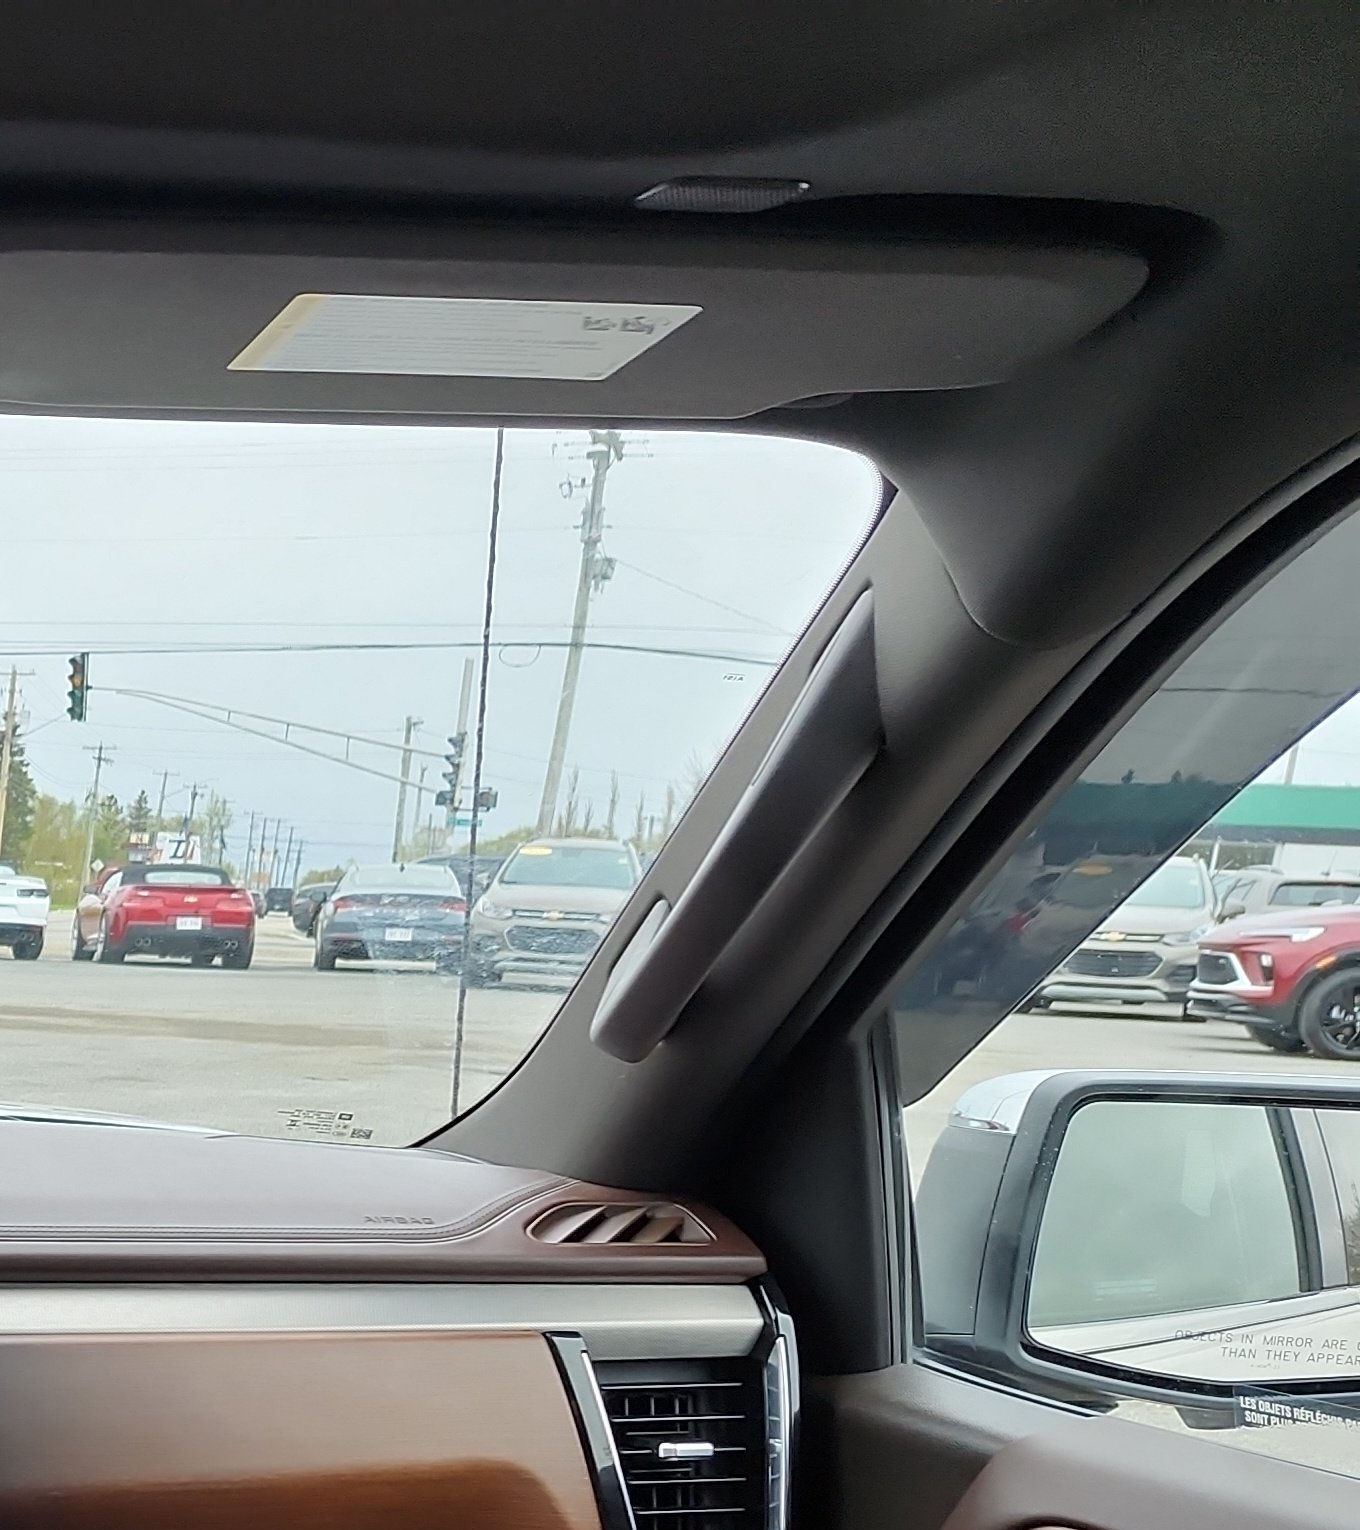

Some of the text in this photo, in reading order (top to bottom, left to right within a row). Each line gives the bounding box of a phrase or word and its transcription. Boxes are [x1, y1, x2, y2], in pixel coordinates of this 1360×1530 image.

[364, 1216, 435, 1225] AIRBAG
[1174, 1330, 1233, 1343] OBJECTS
[1240, 1334, 1254, 1344] IN
[1262, 1334, 1313, 1348] MIRROR
[1322, 1338, 1348, 1350] ARE
[1221, 1346, 1257, 1360] THAN
[1266, 1349, 1301, 1362] THEY
[1240, 1396, 1257, 1410] LES
[1258, 1399, 1292, 1418] OBJETS
[1244, 1410, 1269, 1427] SONT
